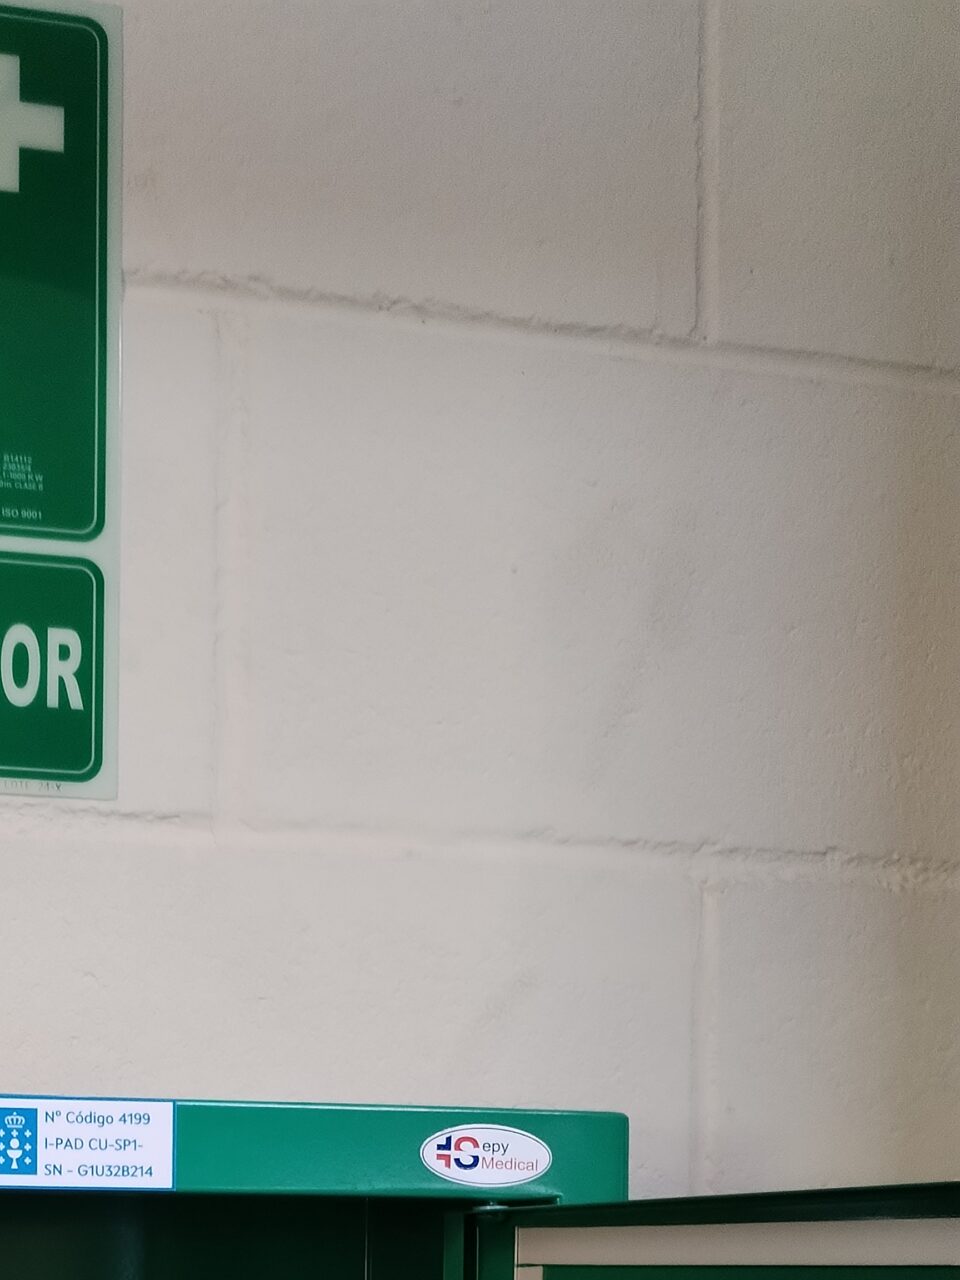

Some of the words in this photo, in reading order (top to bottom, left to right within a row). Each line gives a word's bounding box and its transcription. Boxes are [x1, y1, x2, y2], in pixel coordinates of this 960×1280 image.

[1, 508, 19, 518] ISO
[20, 510, 43, 520] 9001
[44, 1111, 61, 1123] Nº
[66, 1111, 114, 1128] Código
[119, 1112, 151, 1125] 4199
[44, 1138, 84, 1150] I-PAD
[89, 1138, 143, 1151] CU-SP1-
[481, 1156, 538, 1171] Medical
[44, 1164, 62, 1177] SN
[77, 1165, 153, 1178] G1U32B214
